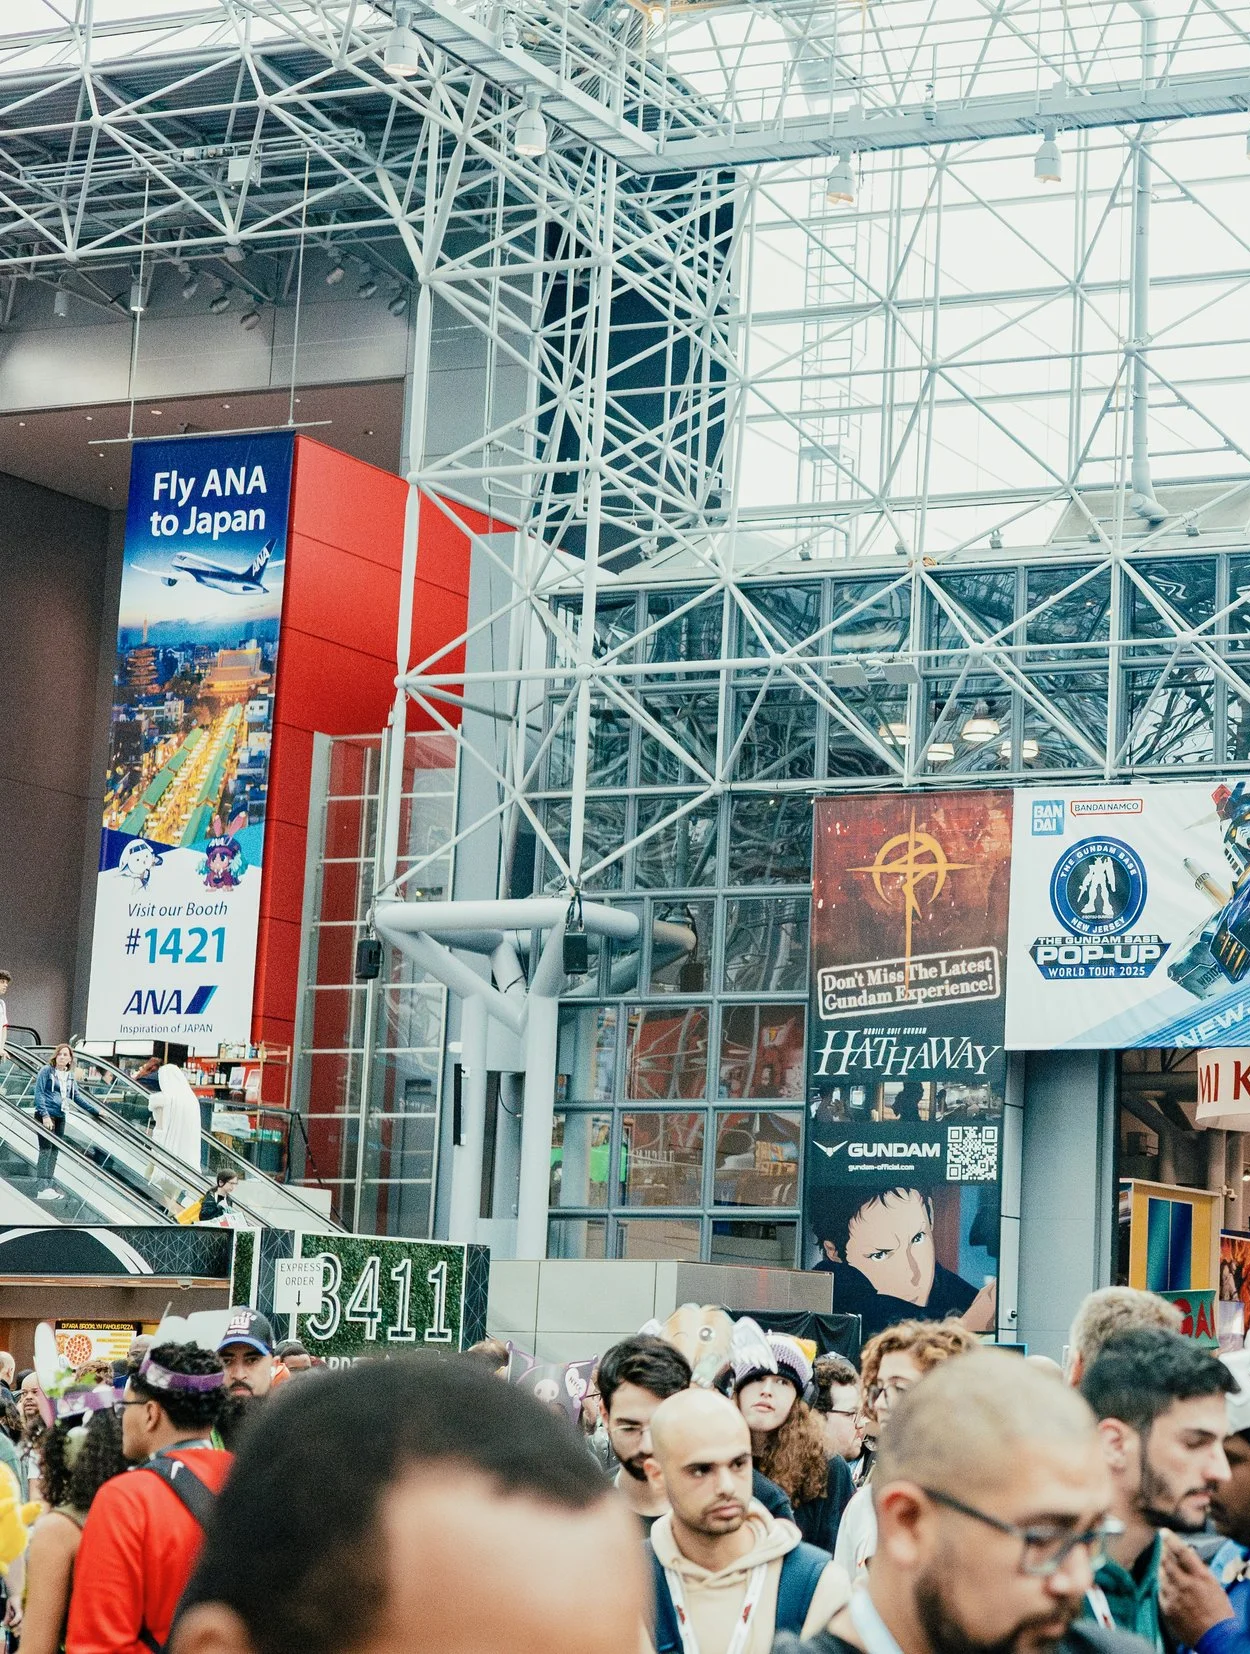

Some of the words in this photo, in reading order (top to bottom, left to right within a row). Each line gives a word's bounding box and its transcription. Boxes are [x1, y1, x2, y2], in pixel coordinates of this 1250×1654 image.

[153, 470, 196, 507] Fly
[201, 465, 267, 497] ANA
[150, 511, 179, 537] to
[183, 506, 266, 541] Japan
[1033, 805, 1063, 818] BAN
[1074, 803, 1106, 812] BANDAI
[1107, 802, 1139, 811] NAMCO
[1033, 819, 1057, 832] DAI
[1059, 859, 1075, 878] THE
[1076, 845, 1117, 859] GUNDAM
[1118, 852, 1138, 876] BASE
[128, 903, 155, 917] Visit
[159, 904, 184, 917] our
[186, 901, 228, 916] Booth
[1070, 917, 1090, 932] NEW
[1092, 916, 1126, 933] JERSEY
[125, 927, 226, 964] #1421
[1038, 937, 1062, 945] THE
[1065, 936, 1122, 944] GUNDAM
[1124, 935, 1159, 943] BASE
[1037, 944, 1161, 965] POP-UP
[823, 971, 864, 992] Don't
[866, 968, 904, 986] Miss
[905, 962, 938, 981] The
[939, 956, 993, 975] Latest
[1048, 966, 1085, 977] WORLD
[1089, 966, 1115, 976] TOUR
[1119, 966, 1146, 976] 2025
[824, 989, 893, 1011] Gundam
[895, 974, 994, 1004] Experience!
[123, 989, 182, 1015] ANA
[119, 1024, 168, 1036] Inspiration
[169, 1023, 181, 1033] of
[182, 1023, 213, 1033] JAPAN
[813, 1030, 1002, 1075] HATHAWAY
[848, 1142, 941, 1157] GUNDAM
[848, 1164, 915, 1172] gundam-official.com
[280, 1262, 321, 1273] EXPRESS
[285, 1277, 315, 1286] ORDER
[306, 1252, 452, 1343] 3411
